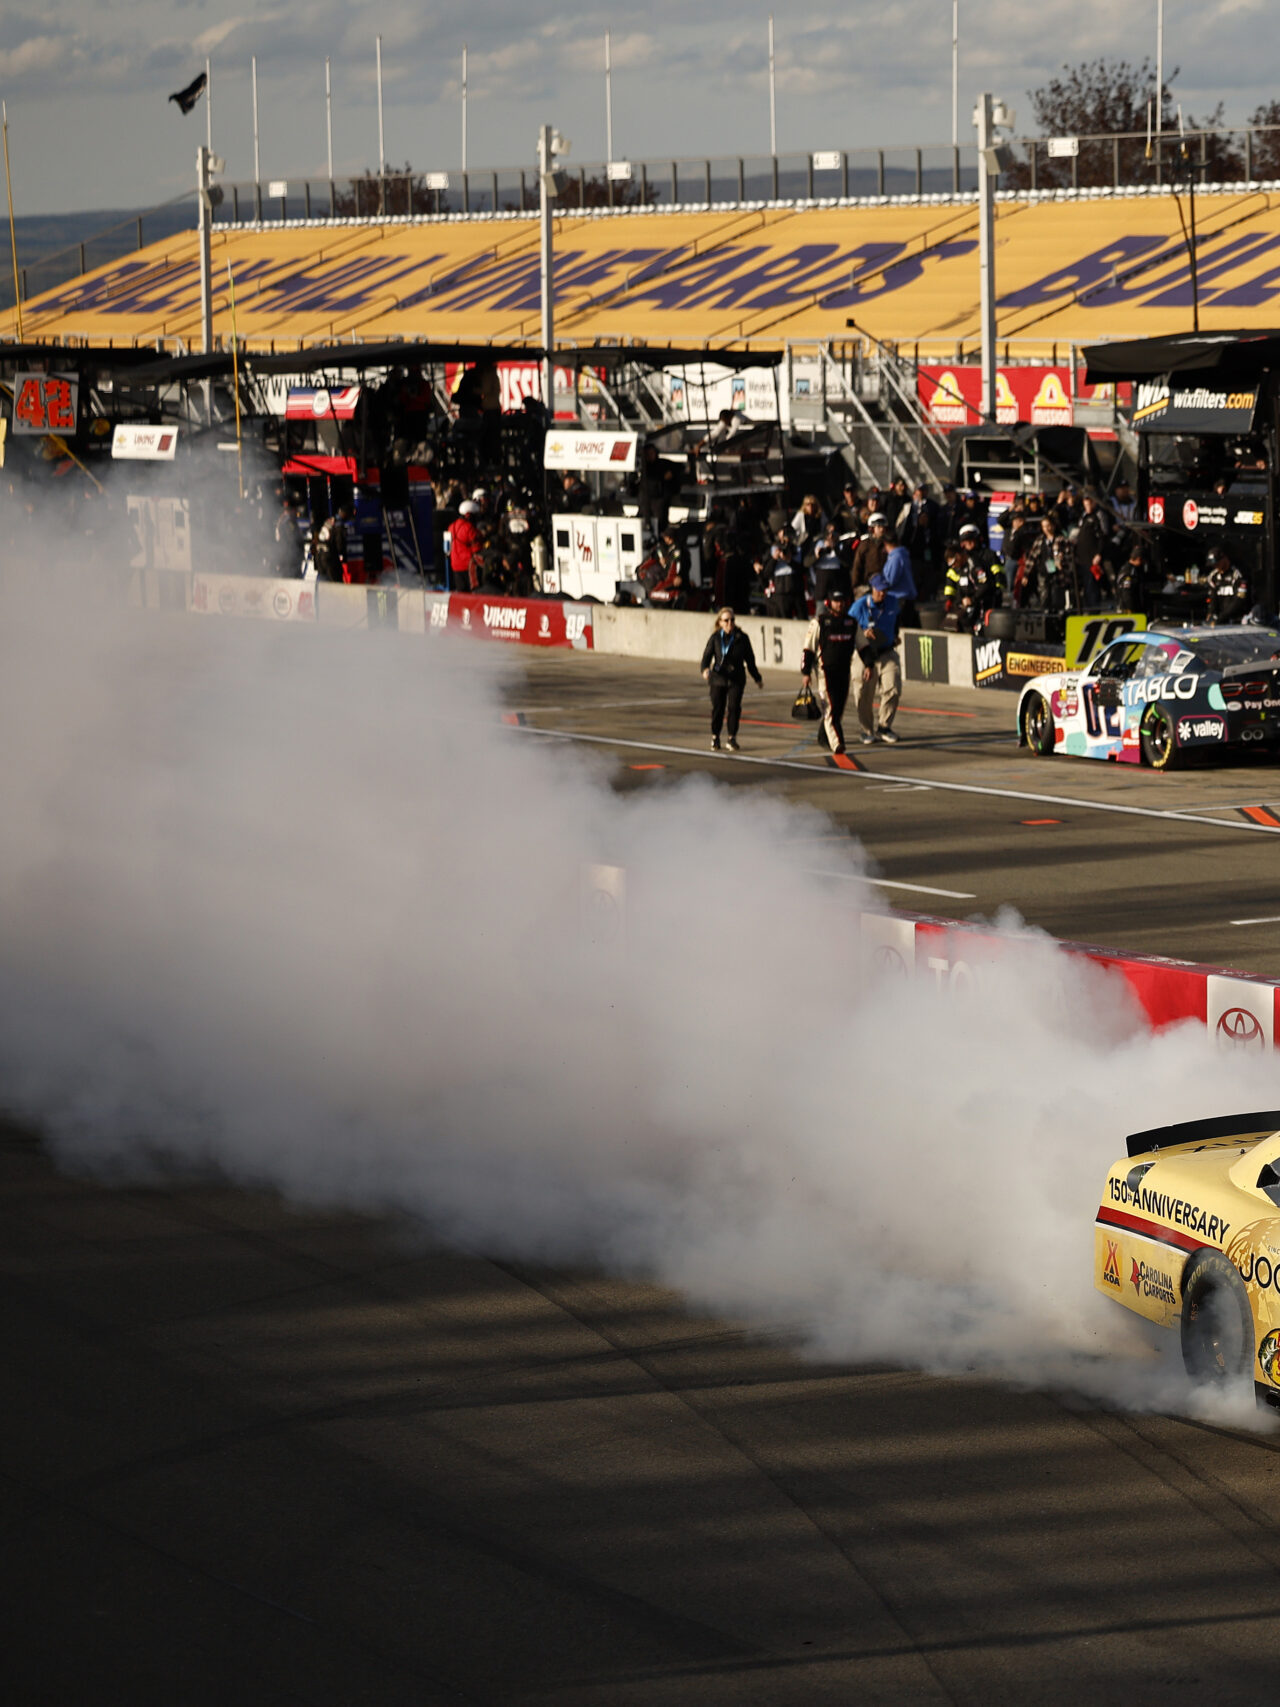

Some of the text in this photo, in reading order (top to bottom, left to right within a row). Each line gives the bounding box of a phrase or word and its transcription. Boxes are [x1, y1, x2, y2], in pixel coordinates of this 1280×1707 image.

[16, 379, 75, 428] 42
[1173, 387, 1255, 410] wixfilters.com
[575, 441, 605, 454] VIKING
[483, 604, 527, 630] VIKING
[760, 625, 783, 664] 15
[975, 639, 1003, 673] WIX
[1008, 656, 1065, 674] ENGINEERED
[1125, 673, 1199, 706] TABLO
[1244, 700, 1263, 710] Pay
[1192, 720, 1225, 740] valley
[1132, 1187, 1231, 1245] ANNIVERSARY
[1103, 1271, 1121, 1287] KOA
[1139, 1261, 1174, 1291] CAROLINA
[1143, 1281, 1176, 1305] CARPORTS
